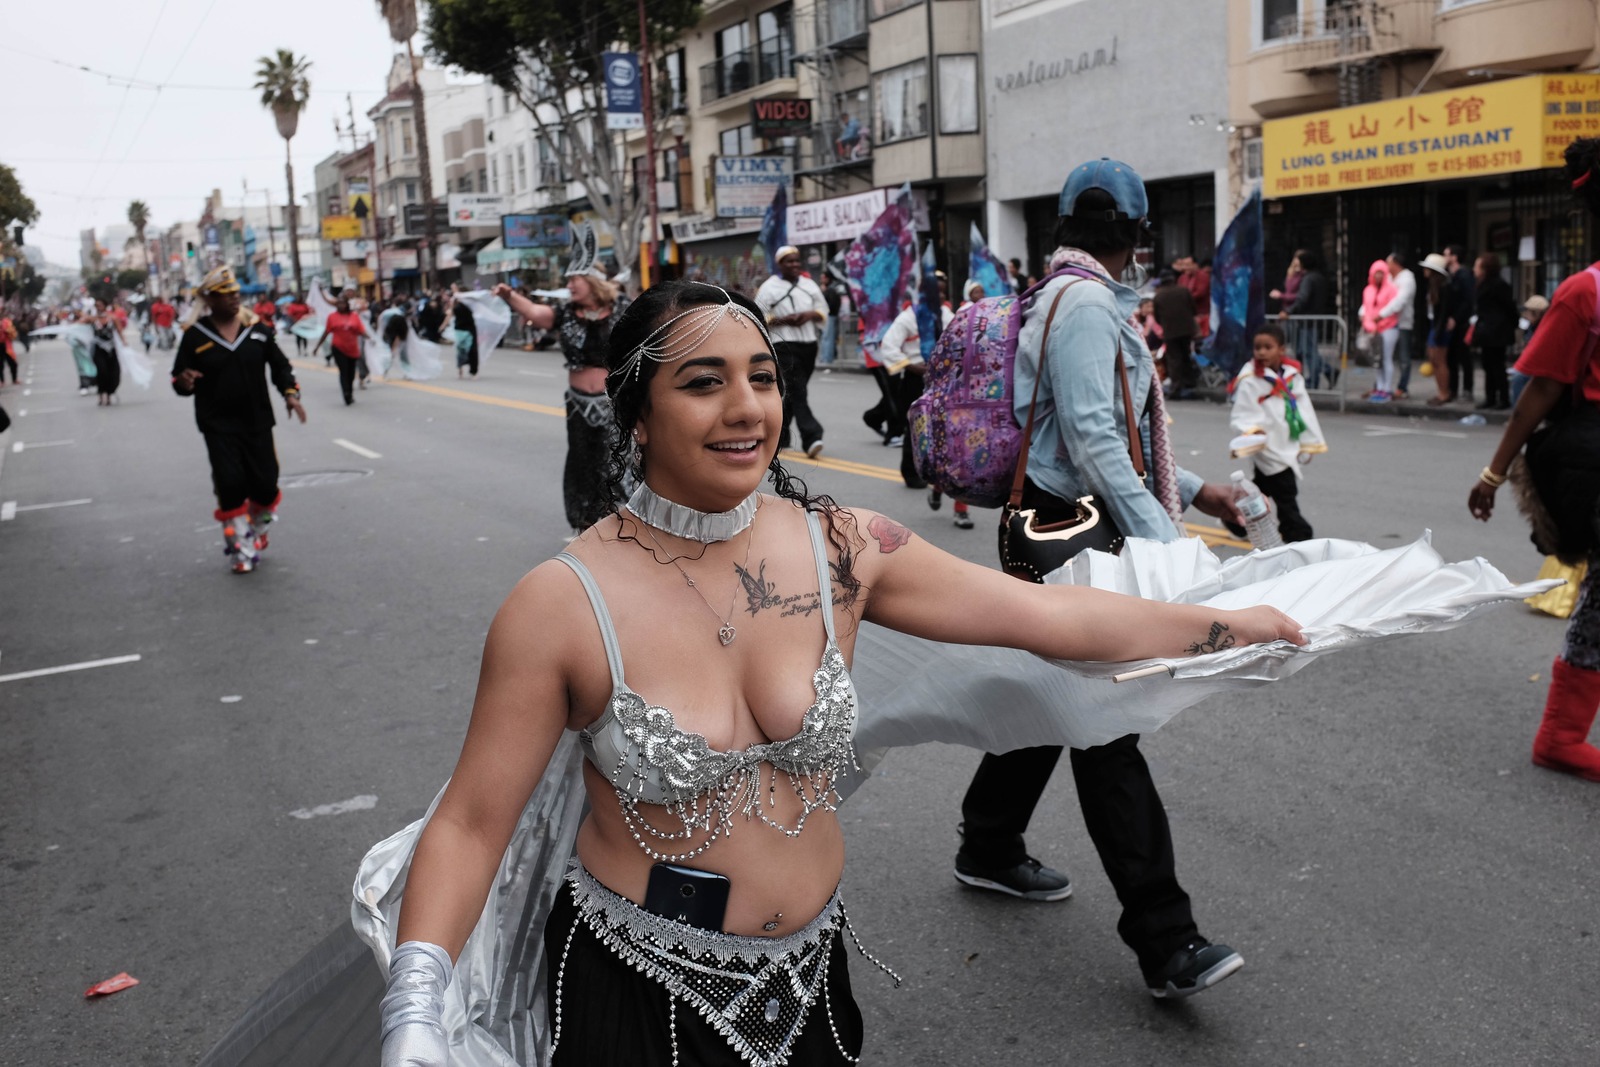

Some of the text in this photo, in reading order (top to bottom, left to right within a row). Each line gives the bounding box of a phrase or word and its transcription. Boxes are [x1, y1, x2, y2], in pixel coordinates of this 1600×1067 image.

[755, 100, 809, 120] VIDEO
[1282, 128, 1513, 170] LUNG SHAN RESTAURANT
[721, 158, 786, 172] VIMY
[1276, 177, 1300, 190] FOOD
[1303, 175, 1314, 187] TO
[1317, 173, 1330, 186] GO
[1339, 168, 1362, 183] FREE
[1367, 163, 1414, 181] DELIVERY
[794, 197, 872, 232] BELLA SALON
[780, 604, 796, 617] and
[1200, 621, 1230, 654] Queen
